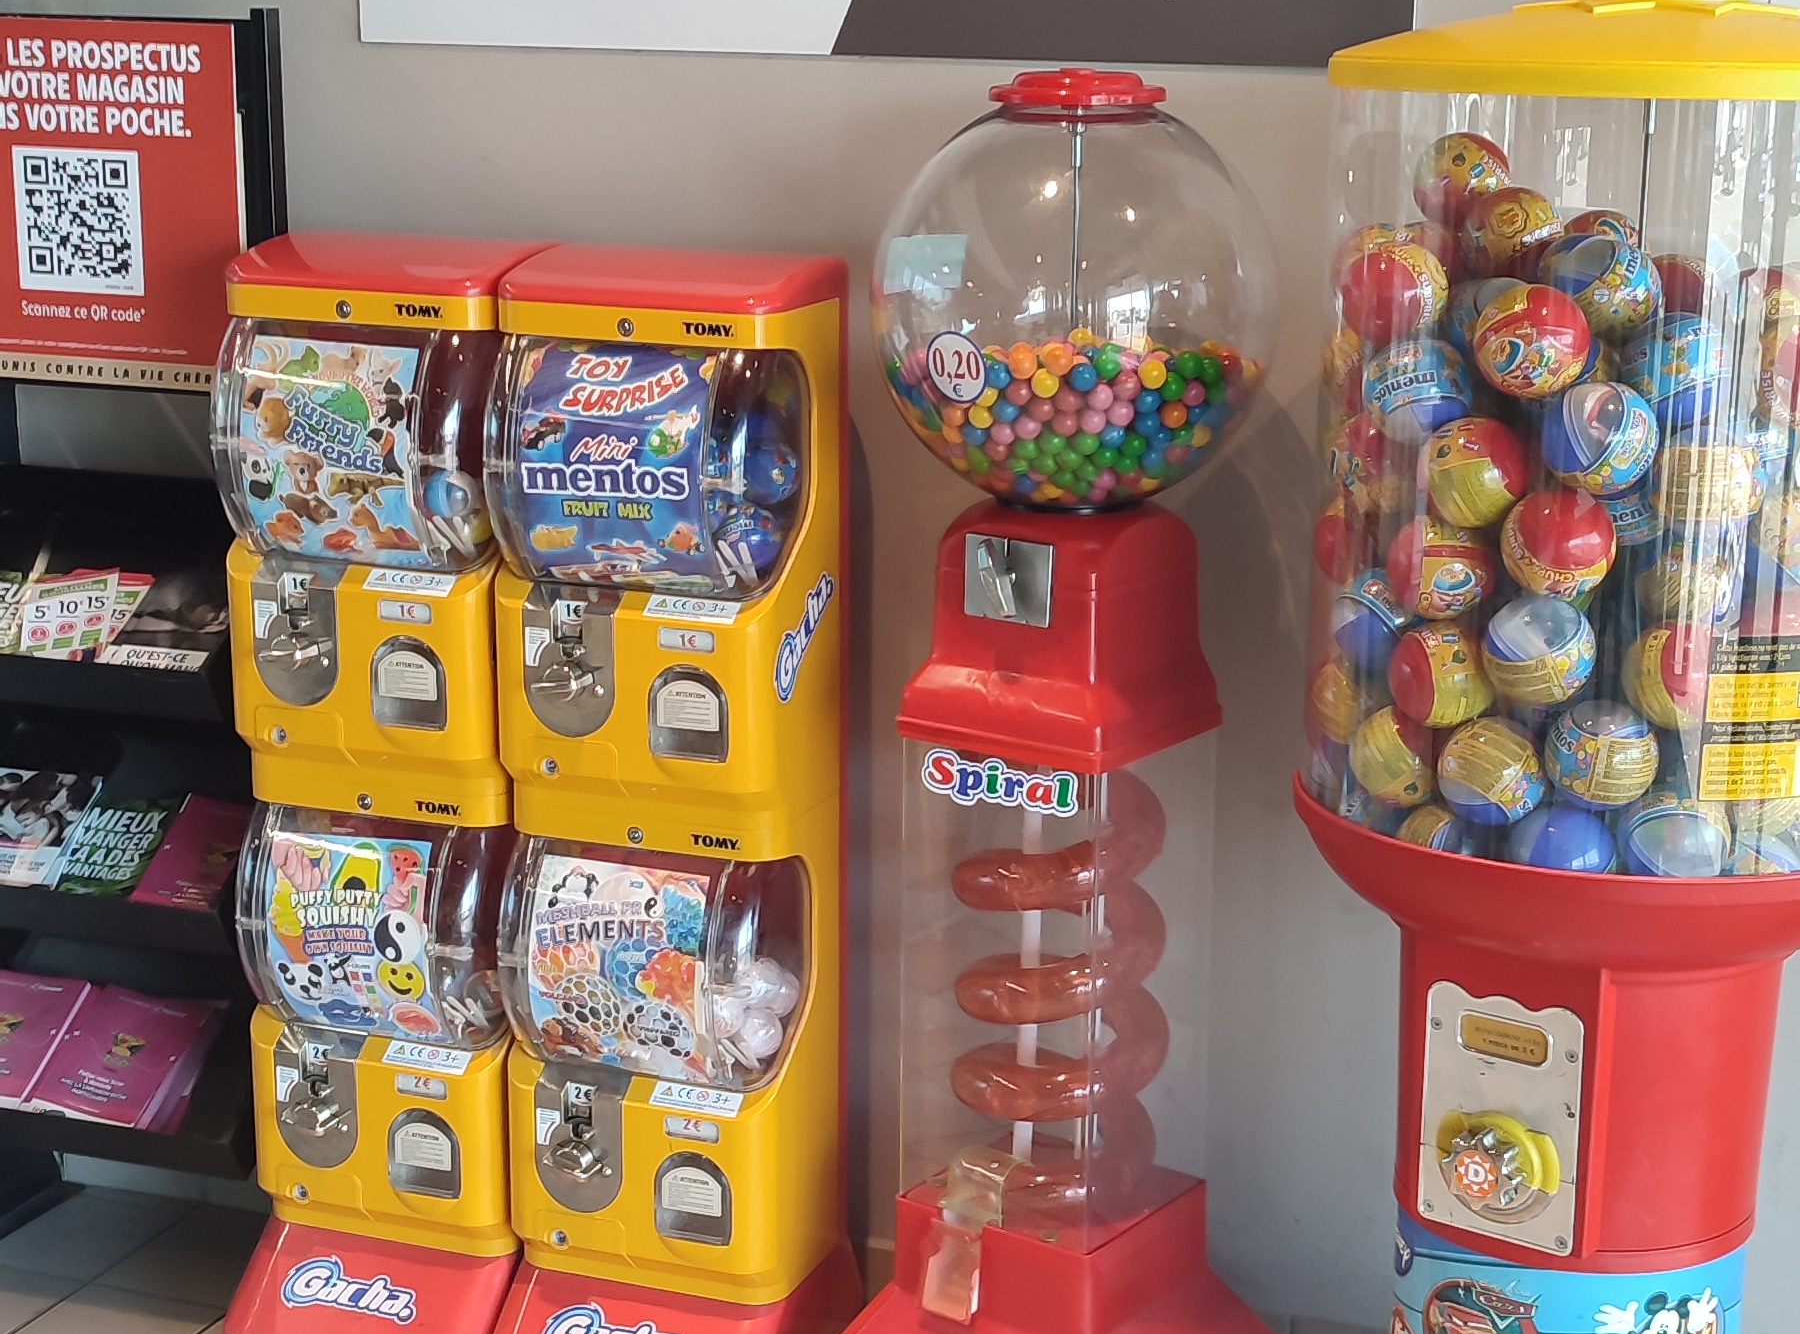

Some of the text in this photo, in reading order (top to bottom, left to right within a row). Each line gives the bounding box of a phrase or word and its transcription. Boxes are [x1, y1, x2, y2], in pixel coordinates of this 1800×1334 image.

[6, 37, 202, 73] LES PROSPECTUS
[77, 73, 185, 106] MAGASIN
[24, 102, 100, 134] VOTRE
[105, 106, 192, 139] POCHE.
[21, 299, 72, 319] Scannez
[74, 306, 88, 320] ce
[90, 303, 109, 322] QR
[45, 363, 104, 378] CONTRE
[113, 367, 131, 380] LA
[140, 369, 165, 382] VIE
[566, 354, 633, 382] TOY
[931, 348, 982, 384] 0,20
[559, 364, 689, 415] SURPRISE
[951, 383, 965, 398] €
[285, 385, 360, 448] Furry
[285, 417, 382, 473] Friends
[570, 434, 638, 463] Mini
[523, 462, 688, 498] mentos
[562, 499, 654, 520] FRUIT MIX
[397, 603, 417, 618] 1€
[564, 603, 583, 618] 1€
[677, 633, 697, 649] 1€
[925, 751, 1077, 814] Spiral
[84, 806, 169, 833] MIEUX
[75, 828, 154, 851] MANGER
[62, 861, 135, 880] VANTAGES
[290, 888, 382, 909] PUFFY PUTTY
[296, 905, 378, 928] SQUISHY
[535, 918, 666, 948] ELEMENTS
[573, 1086, 593, 1103] 2€
